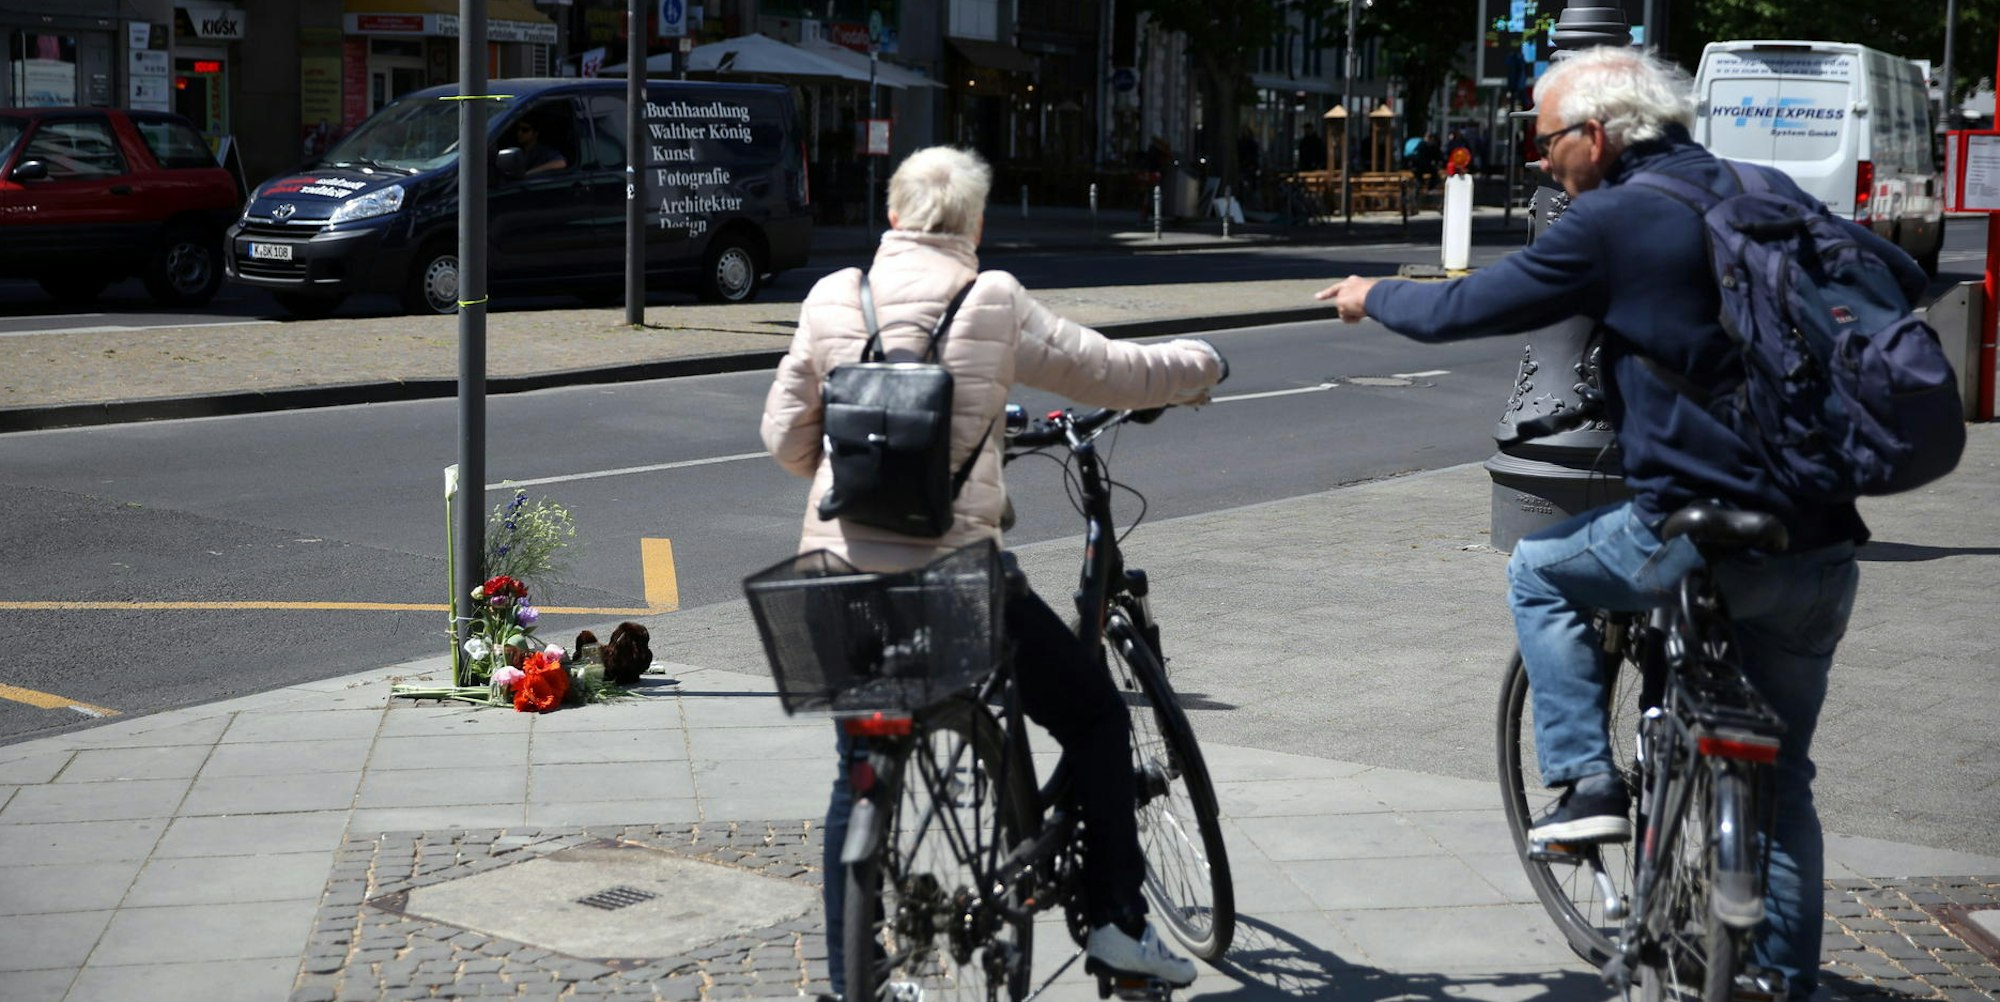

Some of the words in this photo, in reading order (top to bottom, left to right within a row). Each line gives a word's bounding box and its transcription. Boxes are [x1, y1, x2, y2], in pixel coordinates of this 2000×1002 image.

[202, 18, 238, 36] KIOSK
[646, 102, 750, 122] Buchhandlung
[649, 123, 706, 140] Walther
[709, 123, 753, 144] König
[1770, 129, 1806, 138] System
[1807, 129, 1838, 138] GmbH
[652, 145, 696, 162] Kunst
[657, 168, 731, 190] Fotografie
[658, 196, 743, 215] Architektur
